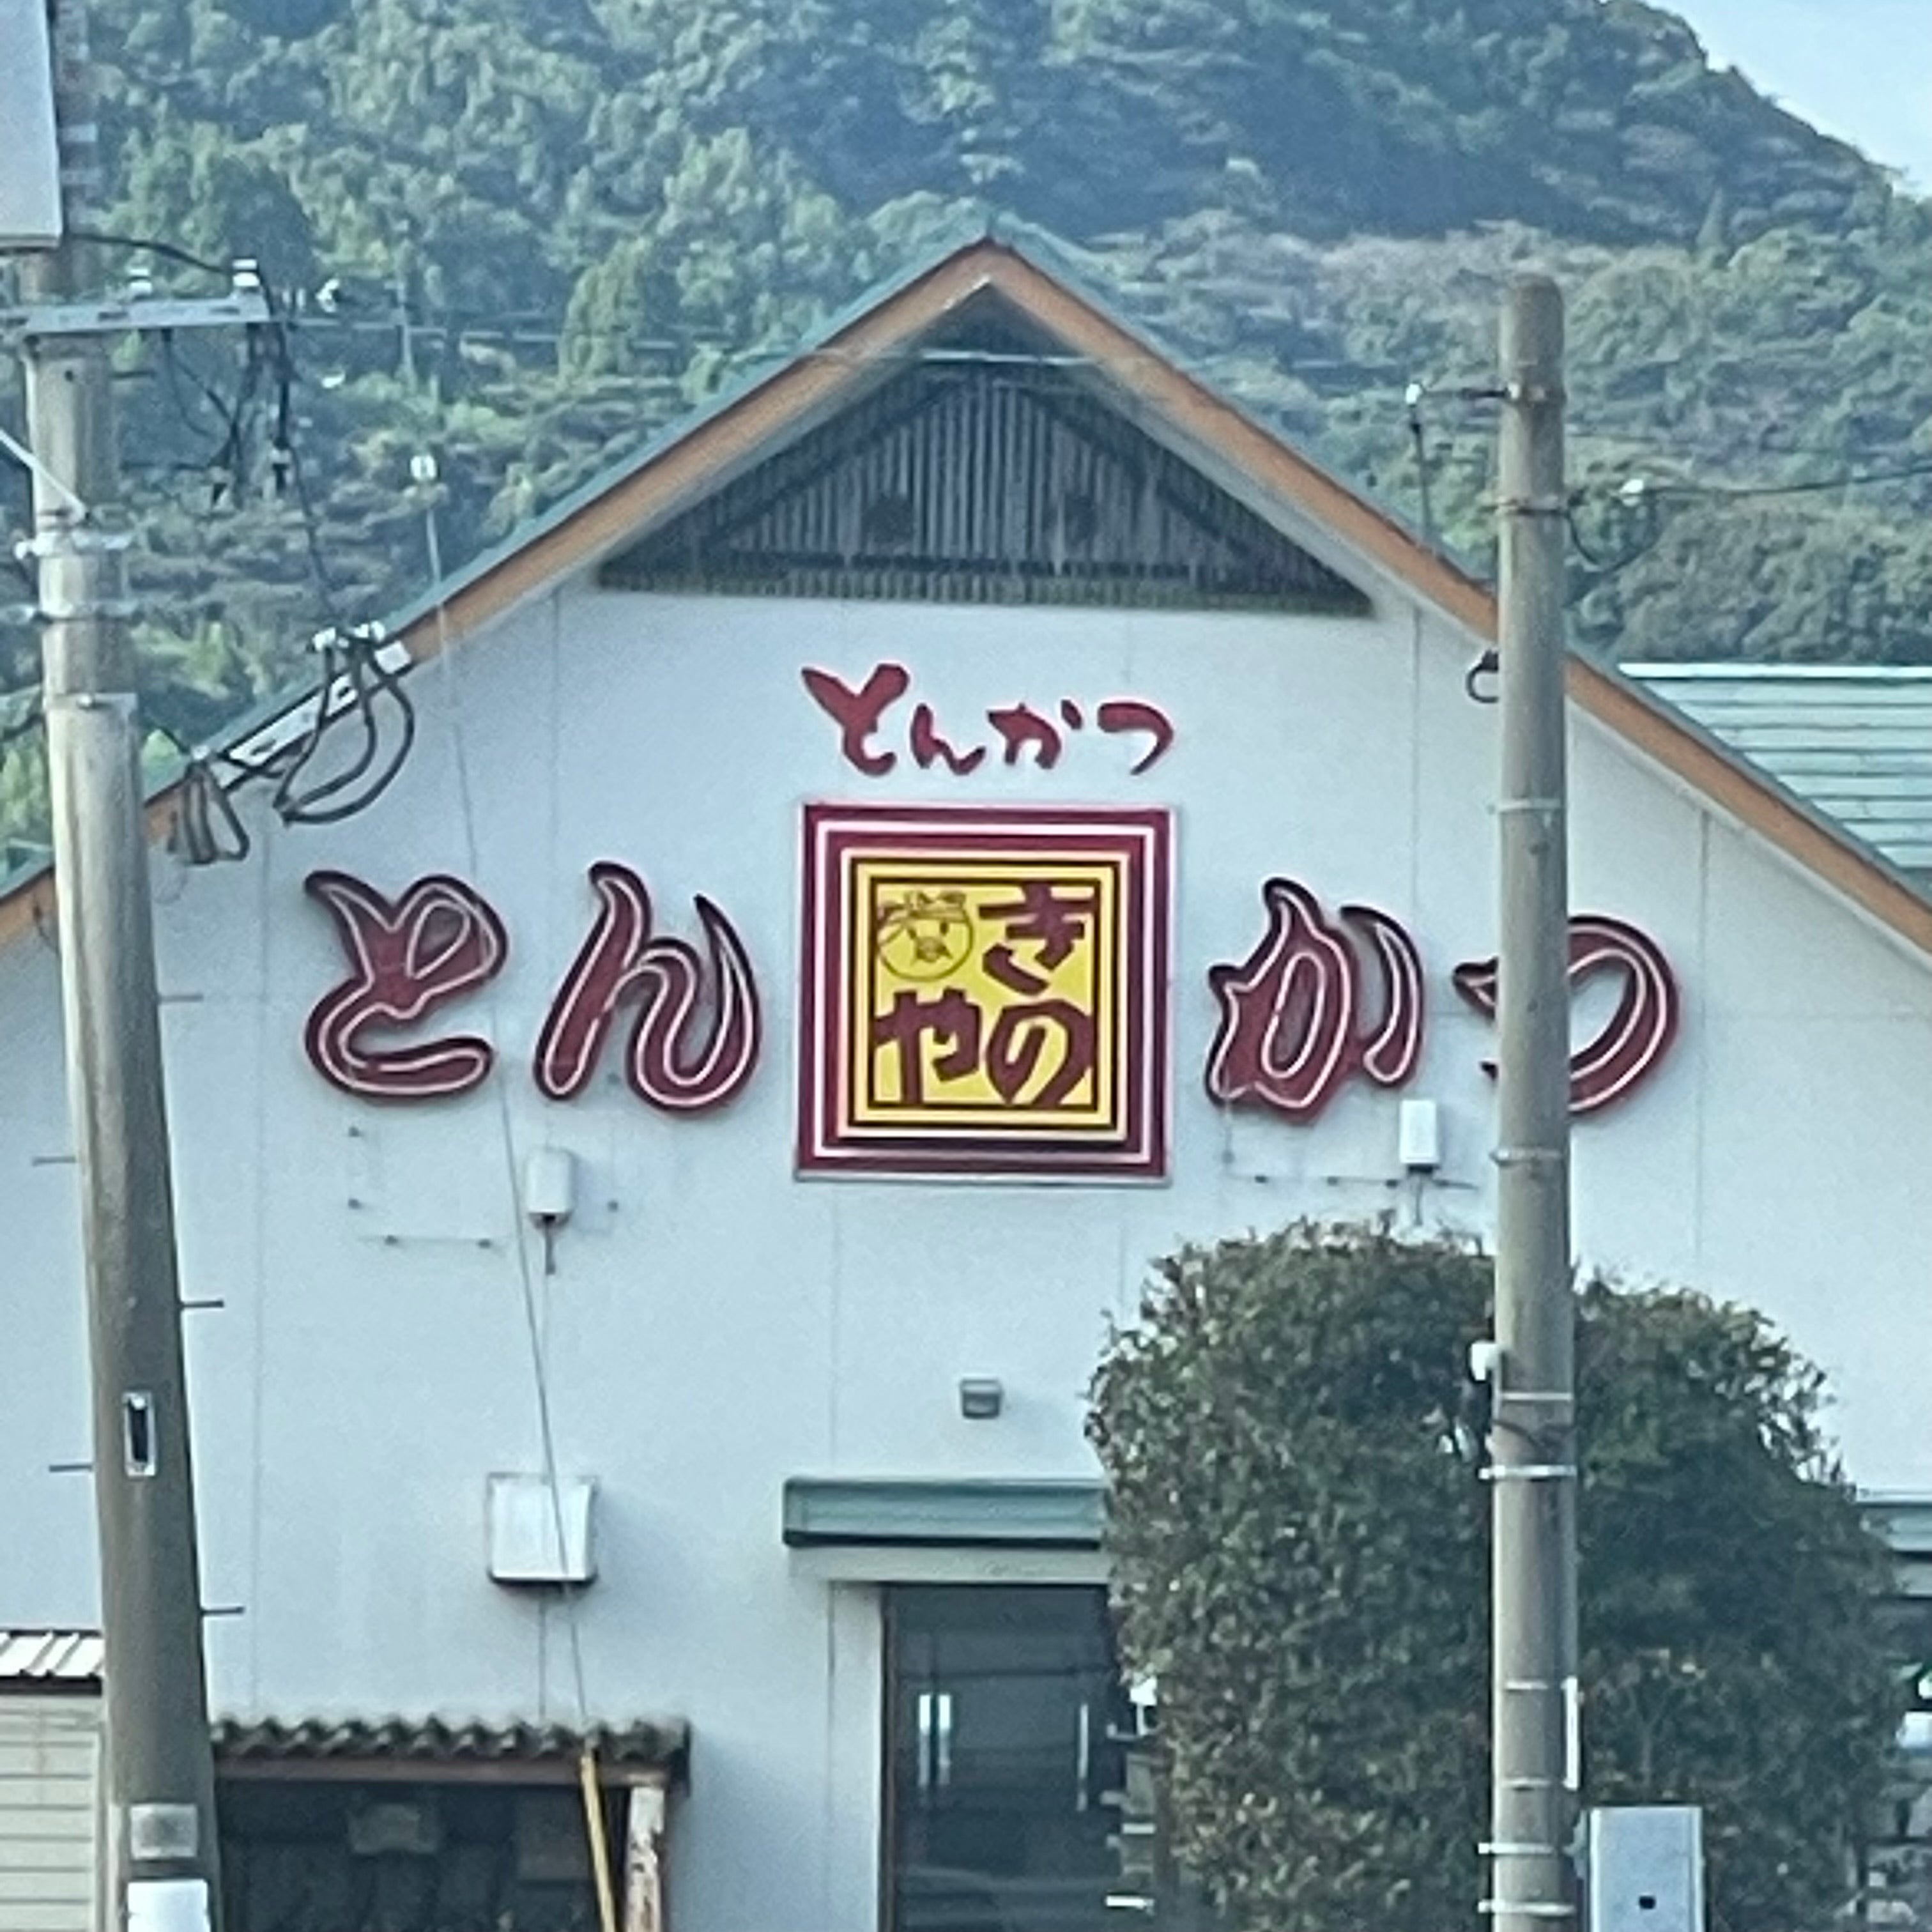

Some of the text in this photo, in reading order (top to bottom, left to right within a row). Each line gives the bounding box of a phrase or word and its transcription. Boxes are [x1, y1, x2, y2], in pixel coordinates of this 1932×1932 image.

[801, 663, 1174, 776] とんかつ
[303, 860, 762, 1117] とん
